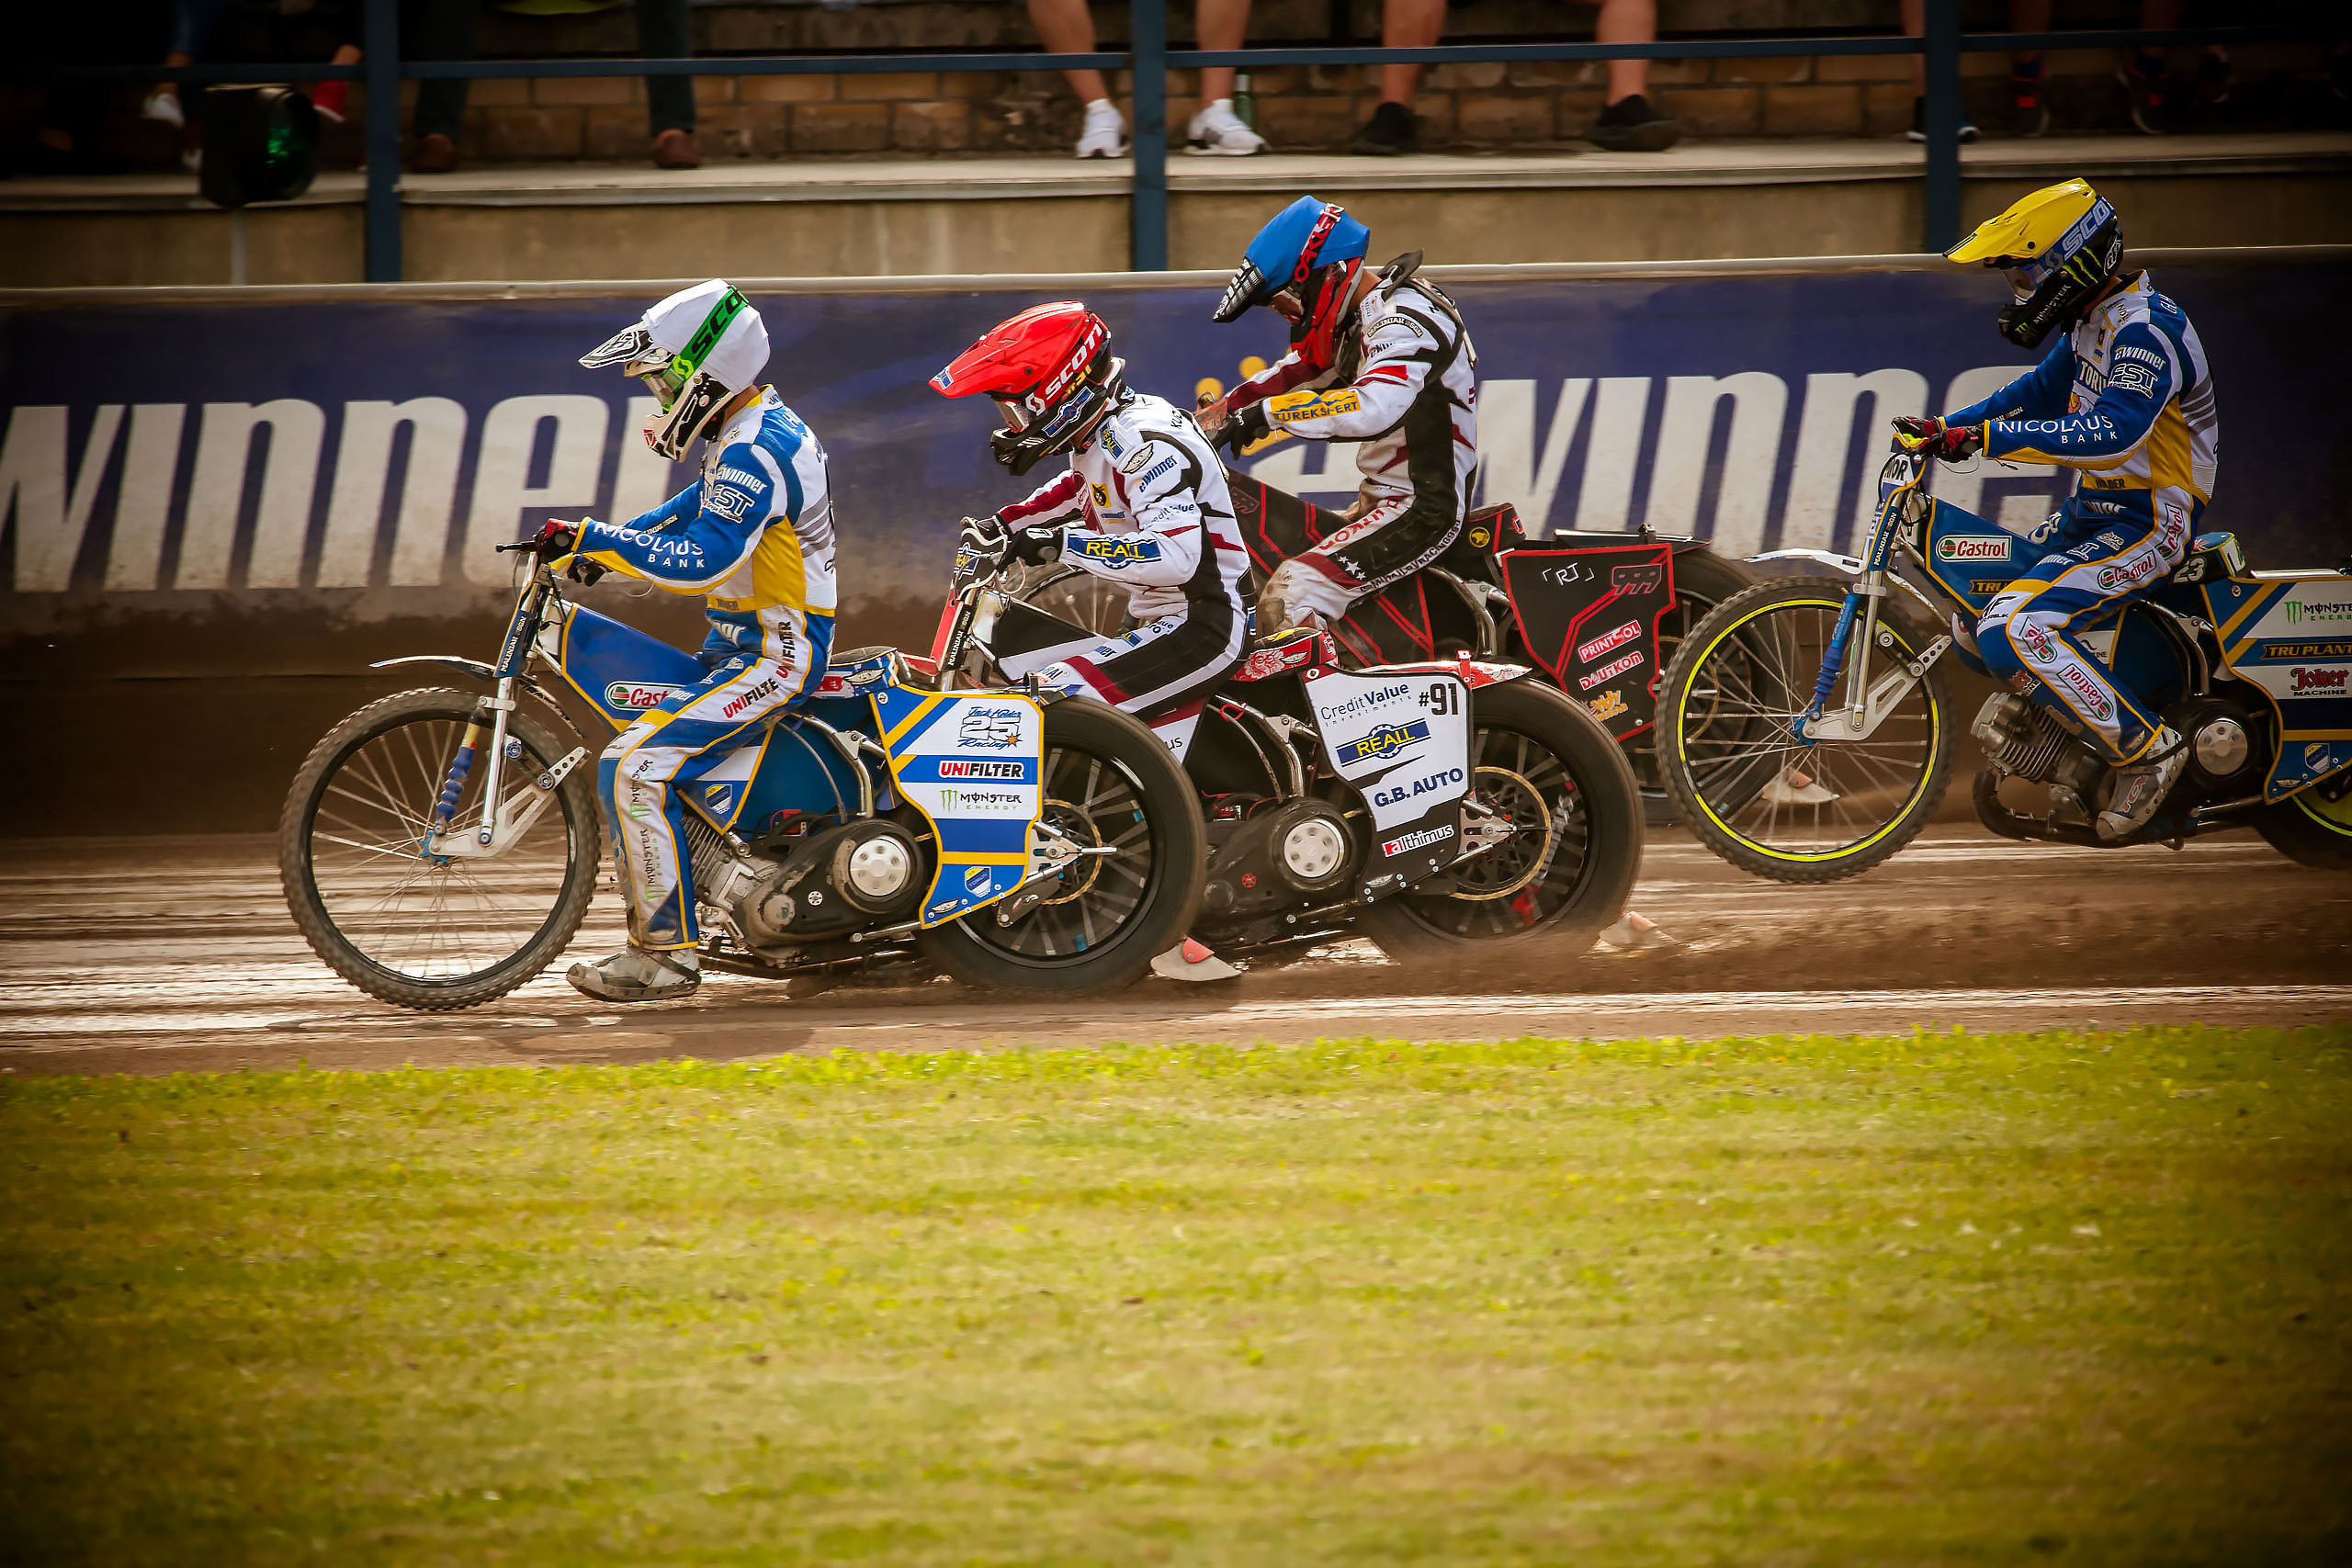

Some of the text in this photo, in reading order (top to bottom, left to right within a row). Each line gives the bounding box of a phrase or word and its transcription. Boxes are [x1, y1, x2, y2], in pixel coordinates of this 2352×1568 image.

[1998, 415, 2114, 434] NICOLAUS
[2062, 431, 2118, 444] BANK
[1086, 541, 1146, 559] REALL
[1958, 539, 2007, 558] Castrol
[648, 553, 706, 568] BANK
[2113, 555, 2154, 582] Castrol
[2172, 557, 2205, 584] 23
[2270, 646, 2301, 657] TRU
[2064, 666, 2103, 706] Castrol
[2291, 667, 2349, 691] Joker
[960, 715, 1022, 741] 25
[1355, 728, 1416, 757] REALL
[941, 762, 1023, 778] UNIFILTER
[960, 792, 1023, 804] MONSTER
[1374, 768, 1464, 807] G.B. AUTO
[1389, 825, 1453, 853] althimus
